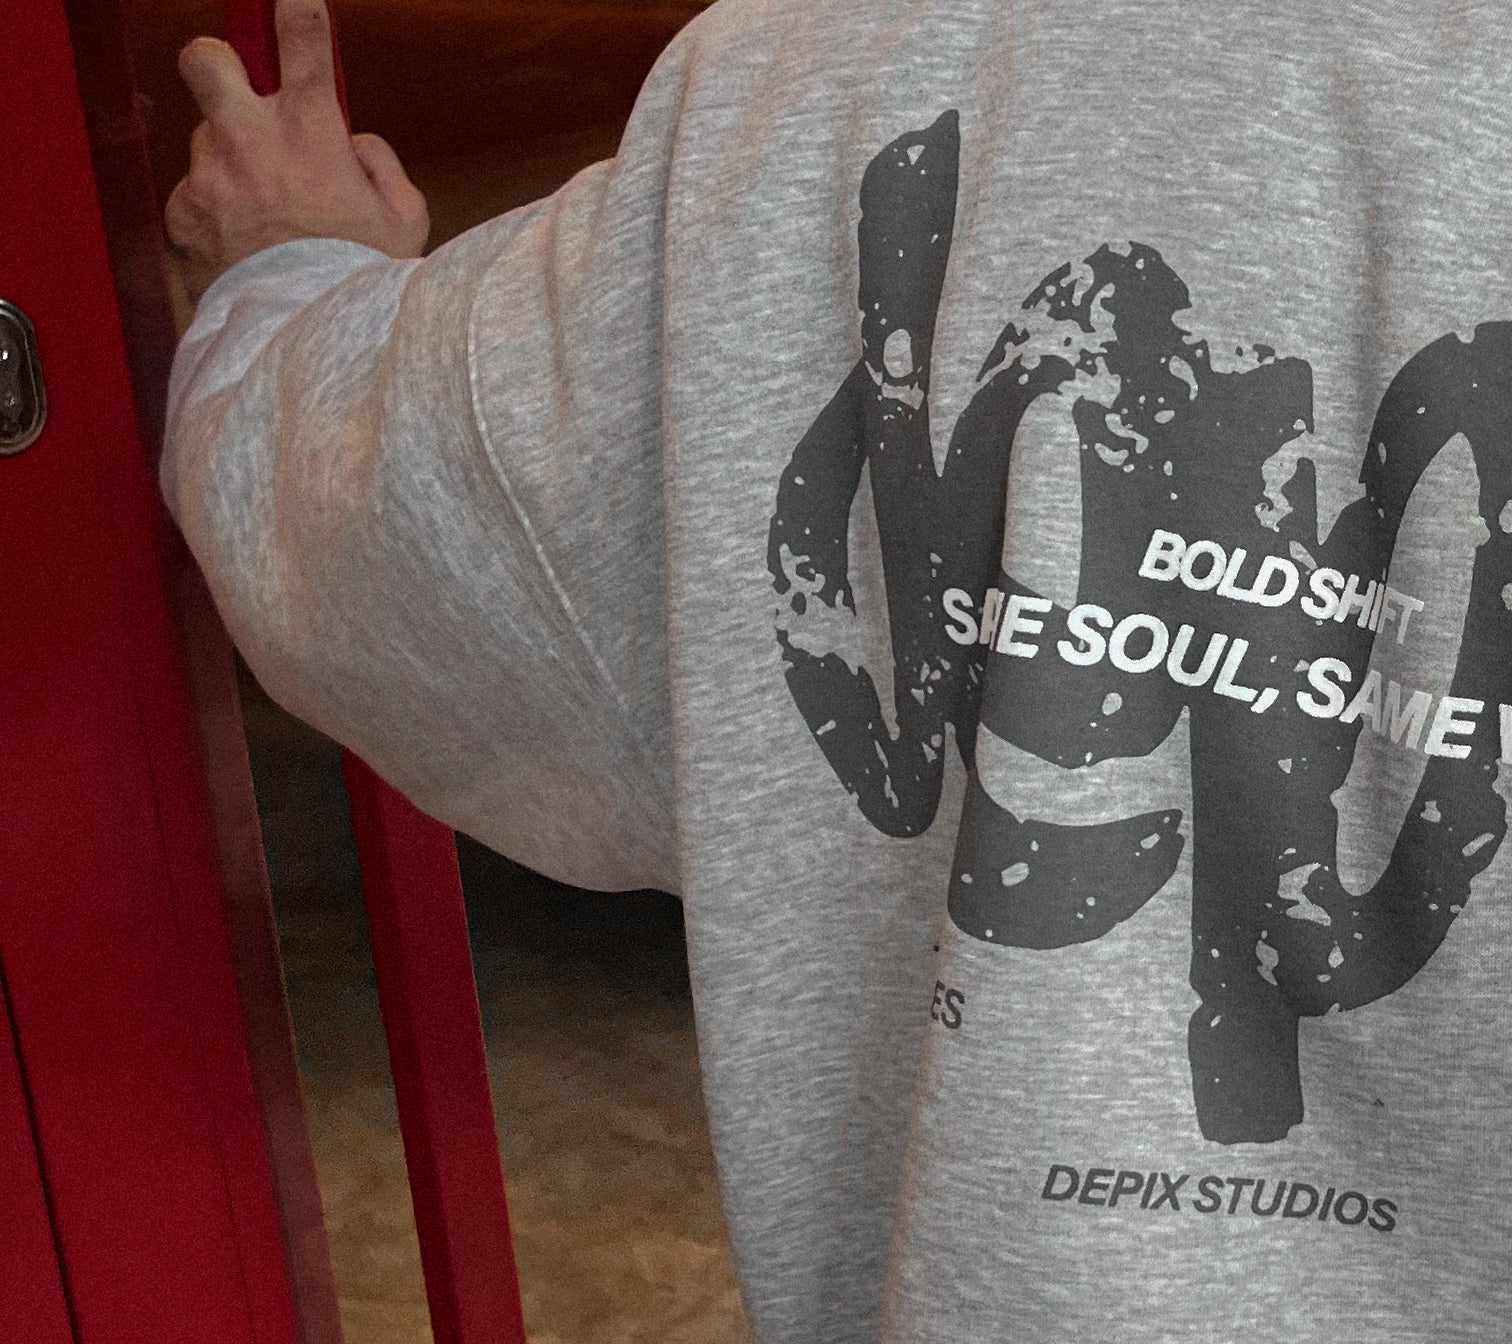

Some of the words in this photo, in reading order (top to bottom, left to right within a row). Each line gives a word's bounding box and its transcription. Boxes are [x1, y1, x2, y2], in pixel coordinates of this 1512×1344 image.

[1138, 528, 1300, 607] BOLD
[1300, 567, 1425, 645] SHIFT
[1057, 603, 1280, 714] SOUL,
[1296, 657, 1485, 759] SAME
[1040, 1163, 1191, 1212] DEPIX
[1191, 1174, 1399, 1233] STUDIOS
